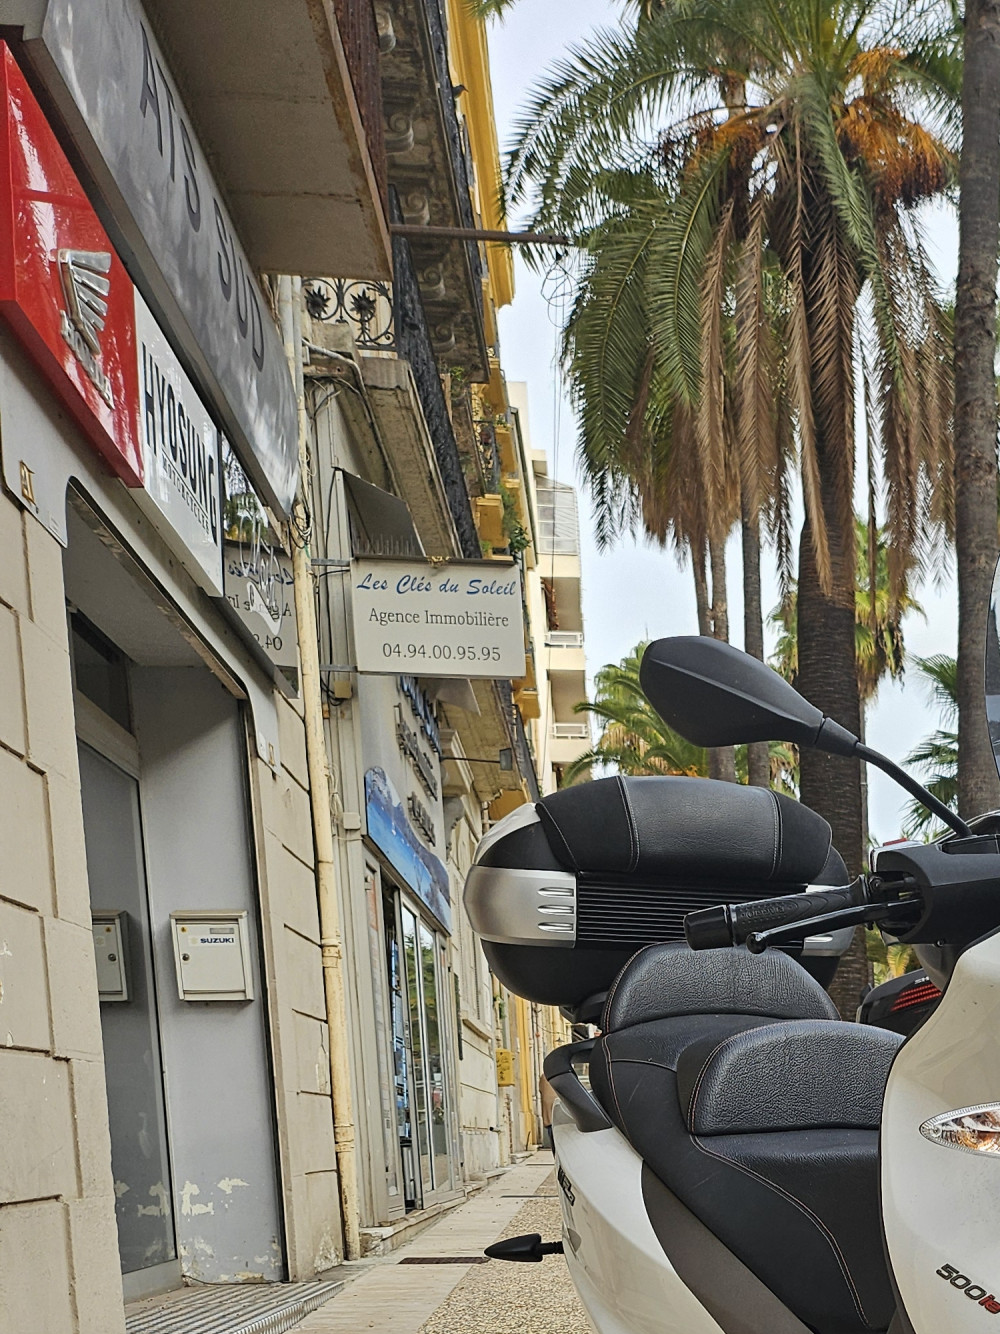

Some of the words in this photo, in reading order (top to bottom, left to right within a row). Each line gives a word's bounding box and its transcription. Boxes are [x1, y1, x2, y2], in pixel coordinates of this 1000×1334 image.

[139, 19, 201, 233] ATS
[213, 196, 265, 373] SUD
[141, 341, 218, 547] HYOSUNG
[162, 452, 210, 536] MOTORCYCLES
[356, 573, 388, 590] Les
[396, 573, 432, 595] Clés
[439, 578, 459, 593] du
[466, 579, 516, 596] Soleil
[368, 607, 420, 626] Agence
[424, 609, 509, 627] Immobilière
[382, 642, 501, 661] 04.94.00.95.95
